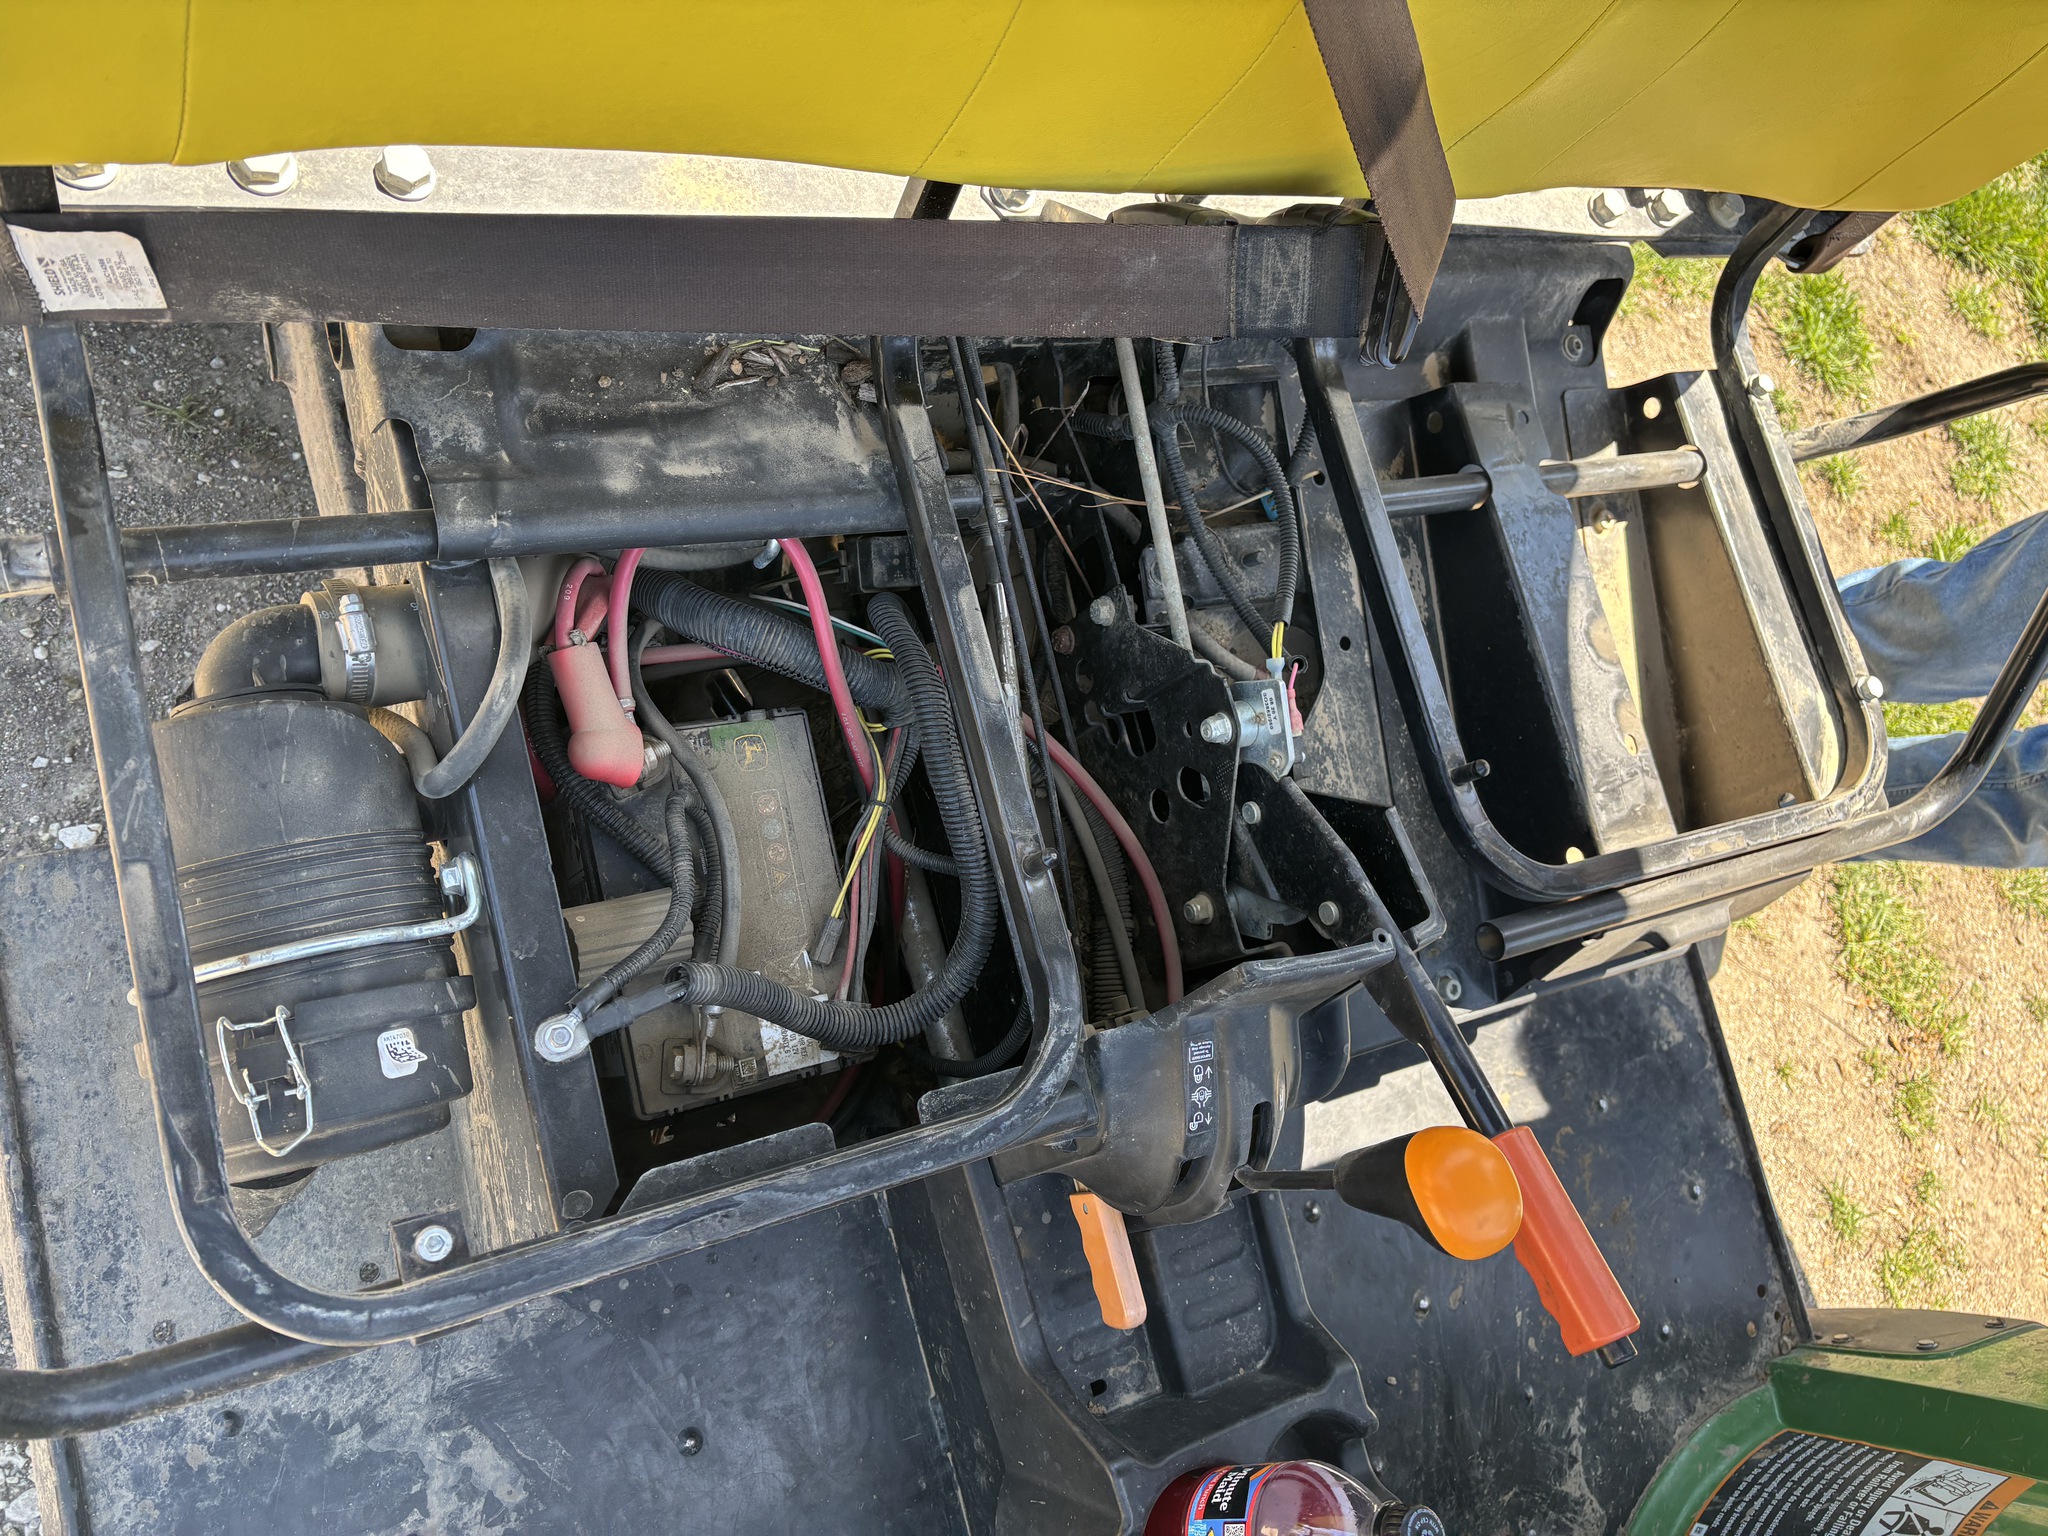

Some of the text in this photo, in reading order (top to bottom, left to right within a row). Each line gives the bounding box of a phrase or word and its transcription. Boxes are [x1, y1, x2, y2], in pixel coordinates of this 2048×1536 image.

[44, 269, 66, 295] SHIELD
[1766, 1463, 1782, 1473] down
[1788, 1467, 1808, 1481] loaded,
[1809, 1466, 1825, 1477] drive
[1880, 1460, 1905, 1473] from
[1763, 1472, 1786, 1492] operating
[1800, 1476, 1815, 1486] slow
[1821, 1470, 1838, 1479] legs
[1850, 1474, 1866, 1485] when
[1211, 1472, 1239, 1503] Maid
[1219, 1467, 1254, 1511] Minute
[1742, 1484, 1761, 1501] Vehicle
[1772, 1487, 1788, 1499] rough
[1791, 1486, 1806, 1495] and
[1804, 1483, 1824, 1498] during
[1835, 1485, 1856, 1500] driving
[1853, 1473, 1888, 1500] Rollover
[1816, 1488, 1836, 1503] higher
[1839, 1470, 1907, 1536] Avoid Injury or Dea
[1719, 1496, 1736, 1512] public
[1732, 1501, 1747, 1513] may
[1780, 1502, 1792, 1511] not
[1797, 1498, 1811, 1509] use.
[1845, 1501, 1859, 1510] or
[1709, 1512, 1724, 1529] roads.
[1756, 1504, 1774, 1522] uneven
[1803, 1503, 1823, 1523] speeds.
